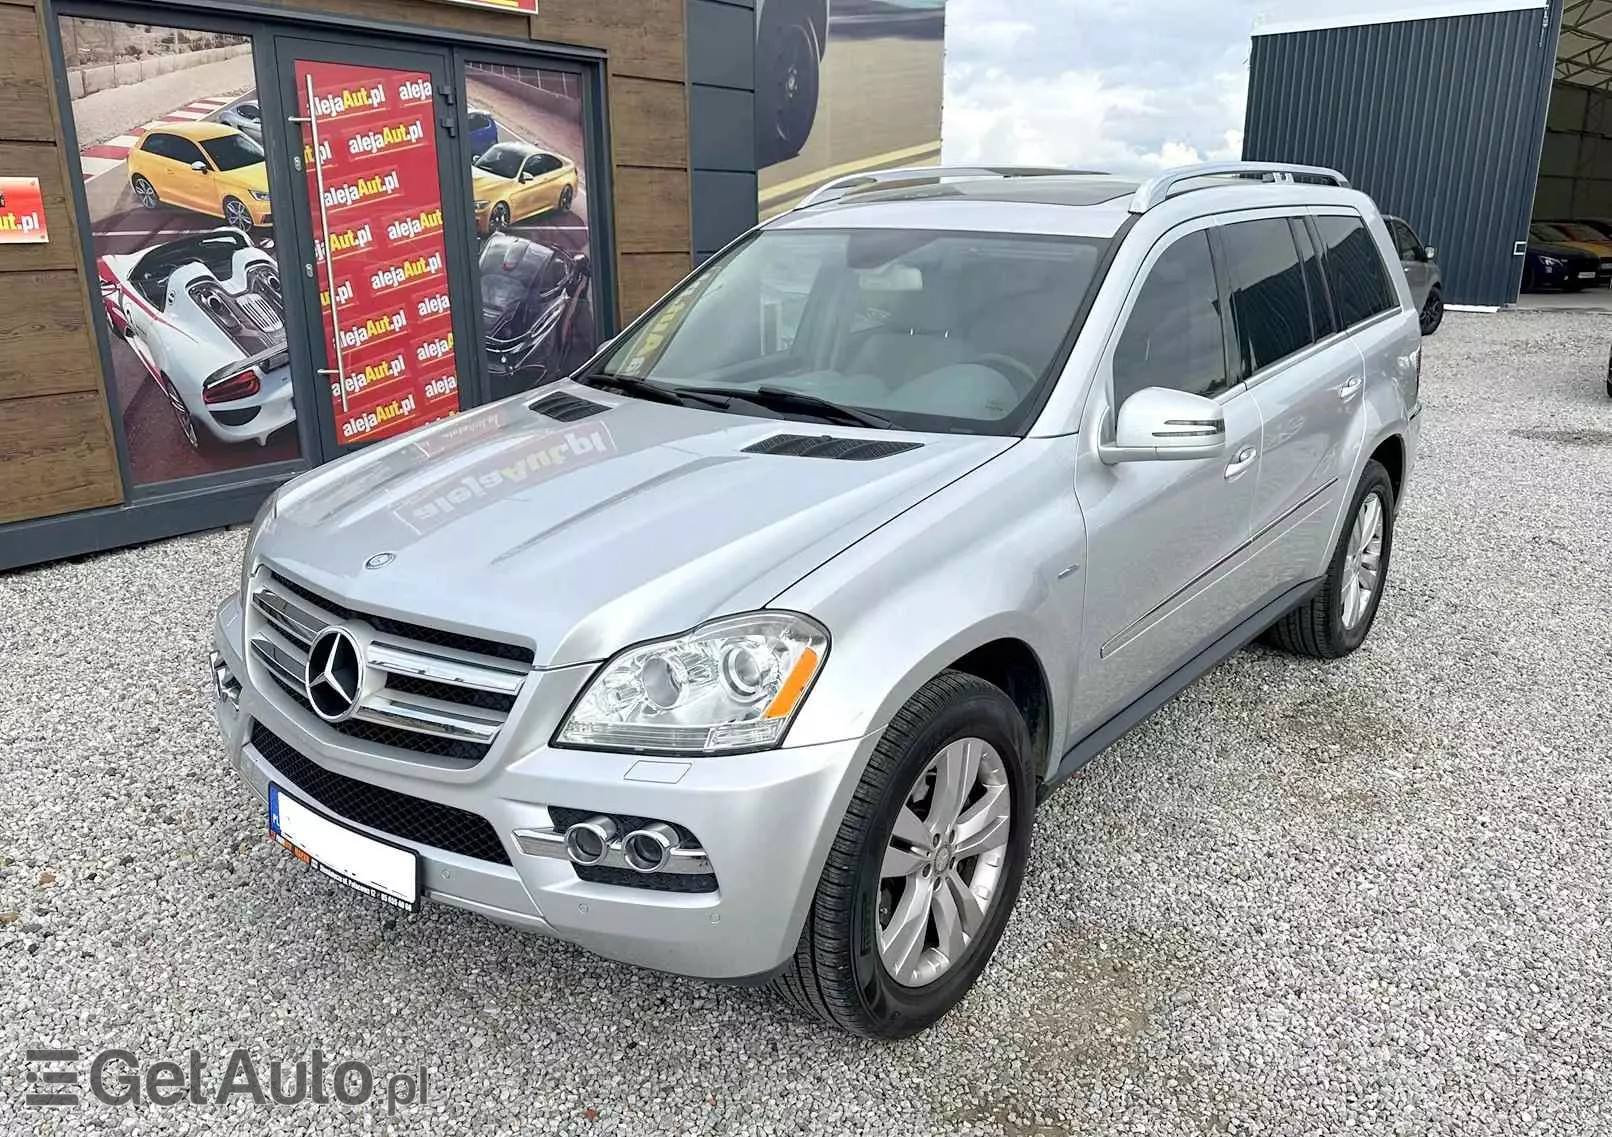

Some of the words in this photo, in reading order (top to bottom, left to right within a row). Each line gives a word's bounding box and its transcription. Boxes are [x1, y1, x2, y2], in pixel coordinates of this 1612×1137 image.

[306, 84, 385, 117] lejaAut.pl
[399, 79, 432, 101] aleja
[348, 120, 424, 154] alejaAut.pl
[323, 171, 400, 207] alejaAut.pl
[370, 252, 443, 290] alejaAut.pl
[417, 294, 450, 317] aleja
[332, 309, 408, 350] lejaAut.pl
[331, 355, 406, 397] aejaAut.pl
[424, 375, 457, 398] aleja
[342, 394, 417, 437] alejaAut.pl
